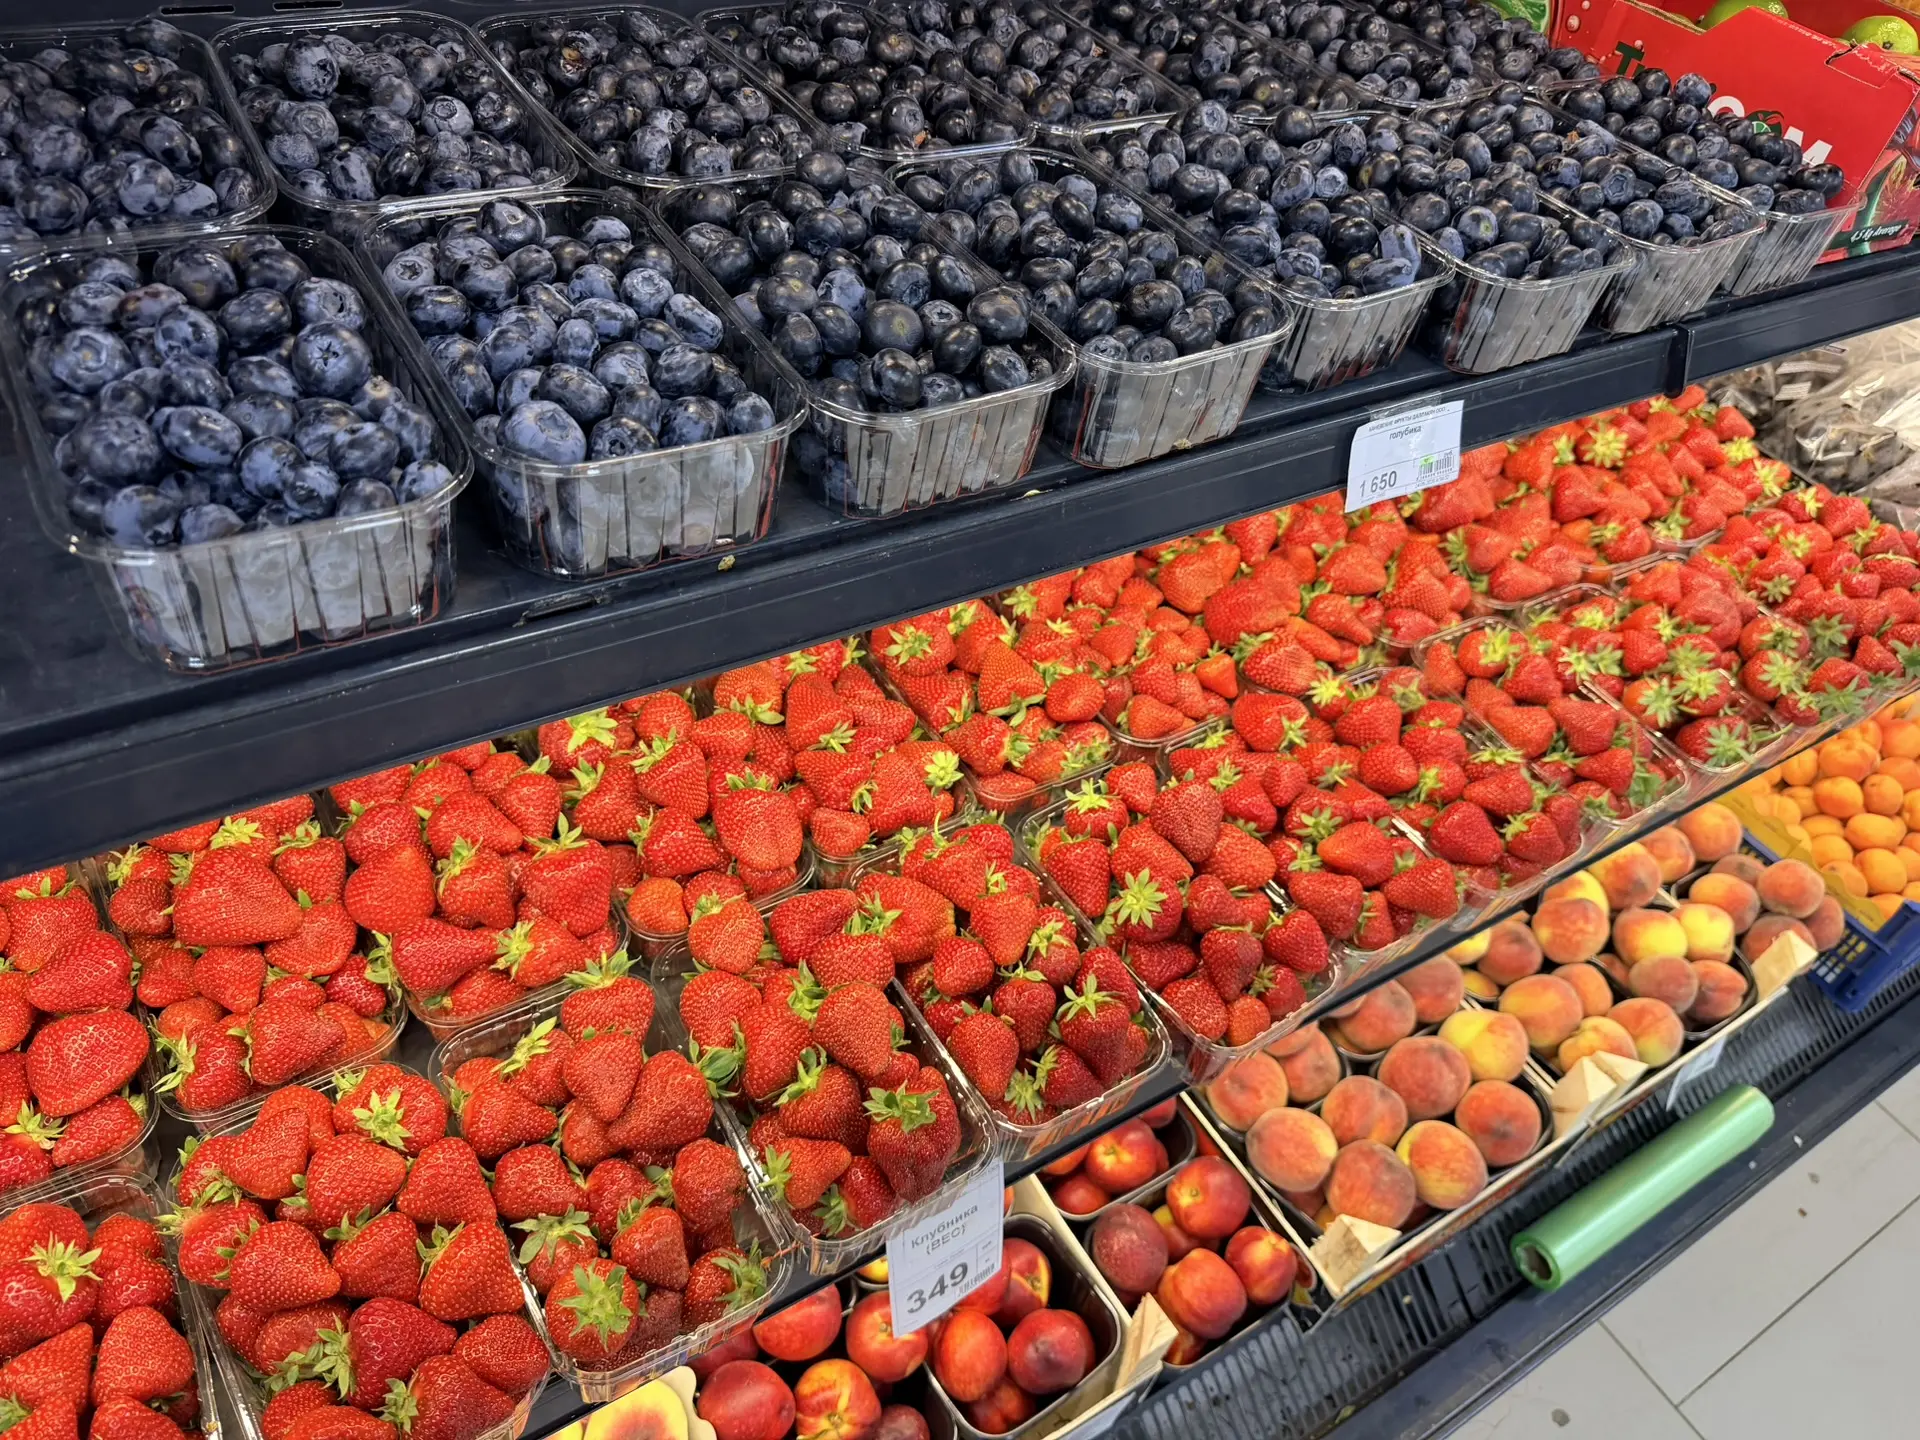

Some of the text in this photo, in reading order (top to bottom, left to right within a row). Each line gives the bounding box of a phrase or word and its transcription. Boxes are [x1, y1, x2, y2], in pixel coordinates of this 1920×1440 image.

[1389, 425, 1422, 440] голубика
[1370, 470, 1397, 493] 650
[911, 1203, 979, 1249] Клубника
[925, 1223, 967, 1255] (ВЕС)
[906, 1261, 969, 1315] 349
